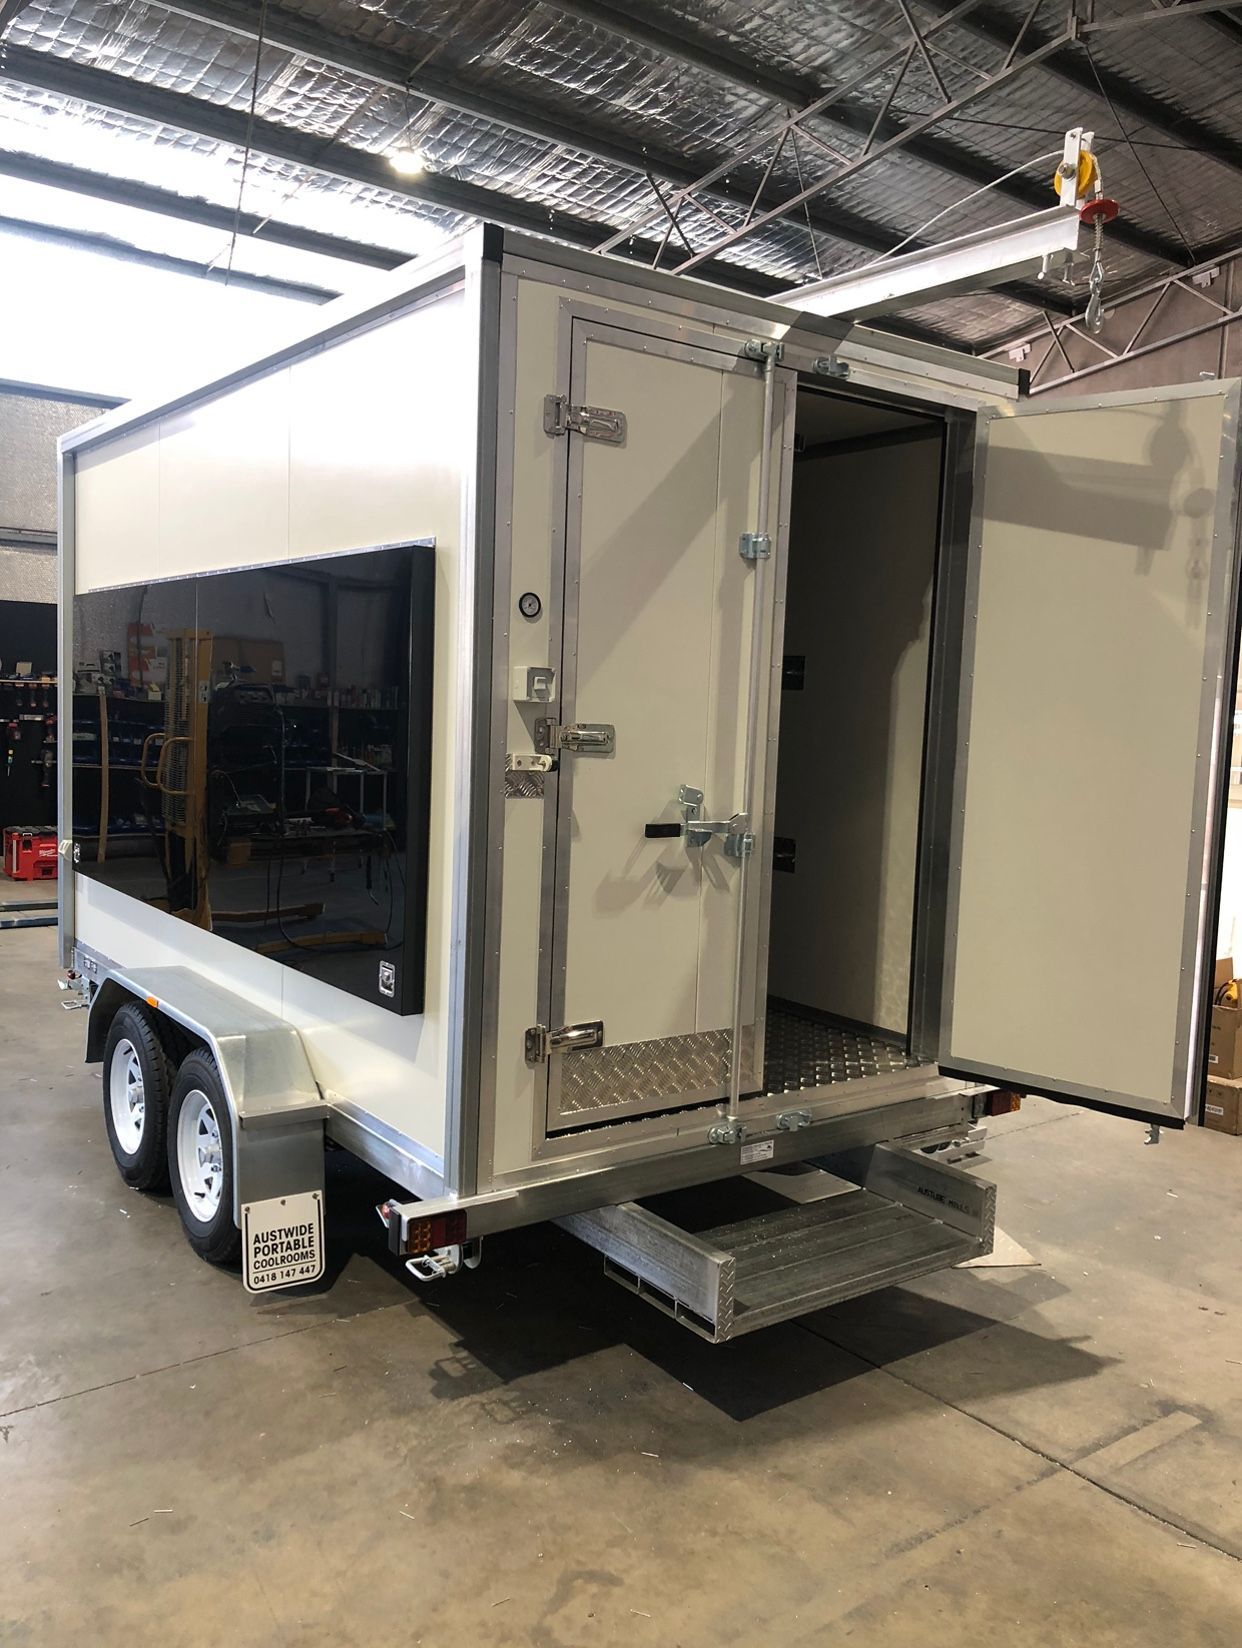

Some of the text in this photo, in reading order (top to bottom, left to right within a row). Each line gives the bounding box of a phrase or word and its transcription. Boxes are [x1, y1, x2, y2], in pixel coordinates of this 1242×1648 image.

[253, 1222, 314, 1245] AUSTWIDE
[254, 1235, 315, 1258] PORTABLE
[253, 1249, 316, 1270] COOLROOMS
[253, 1264, 316, 1285] 0418 147 447
